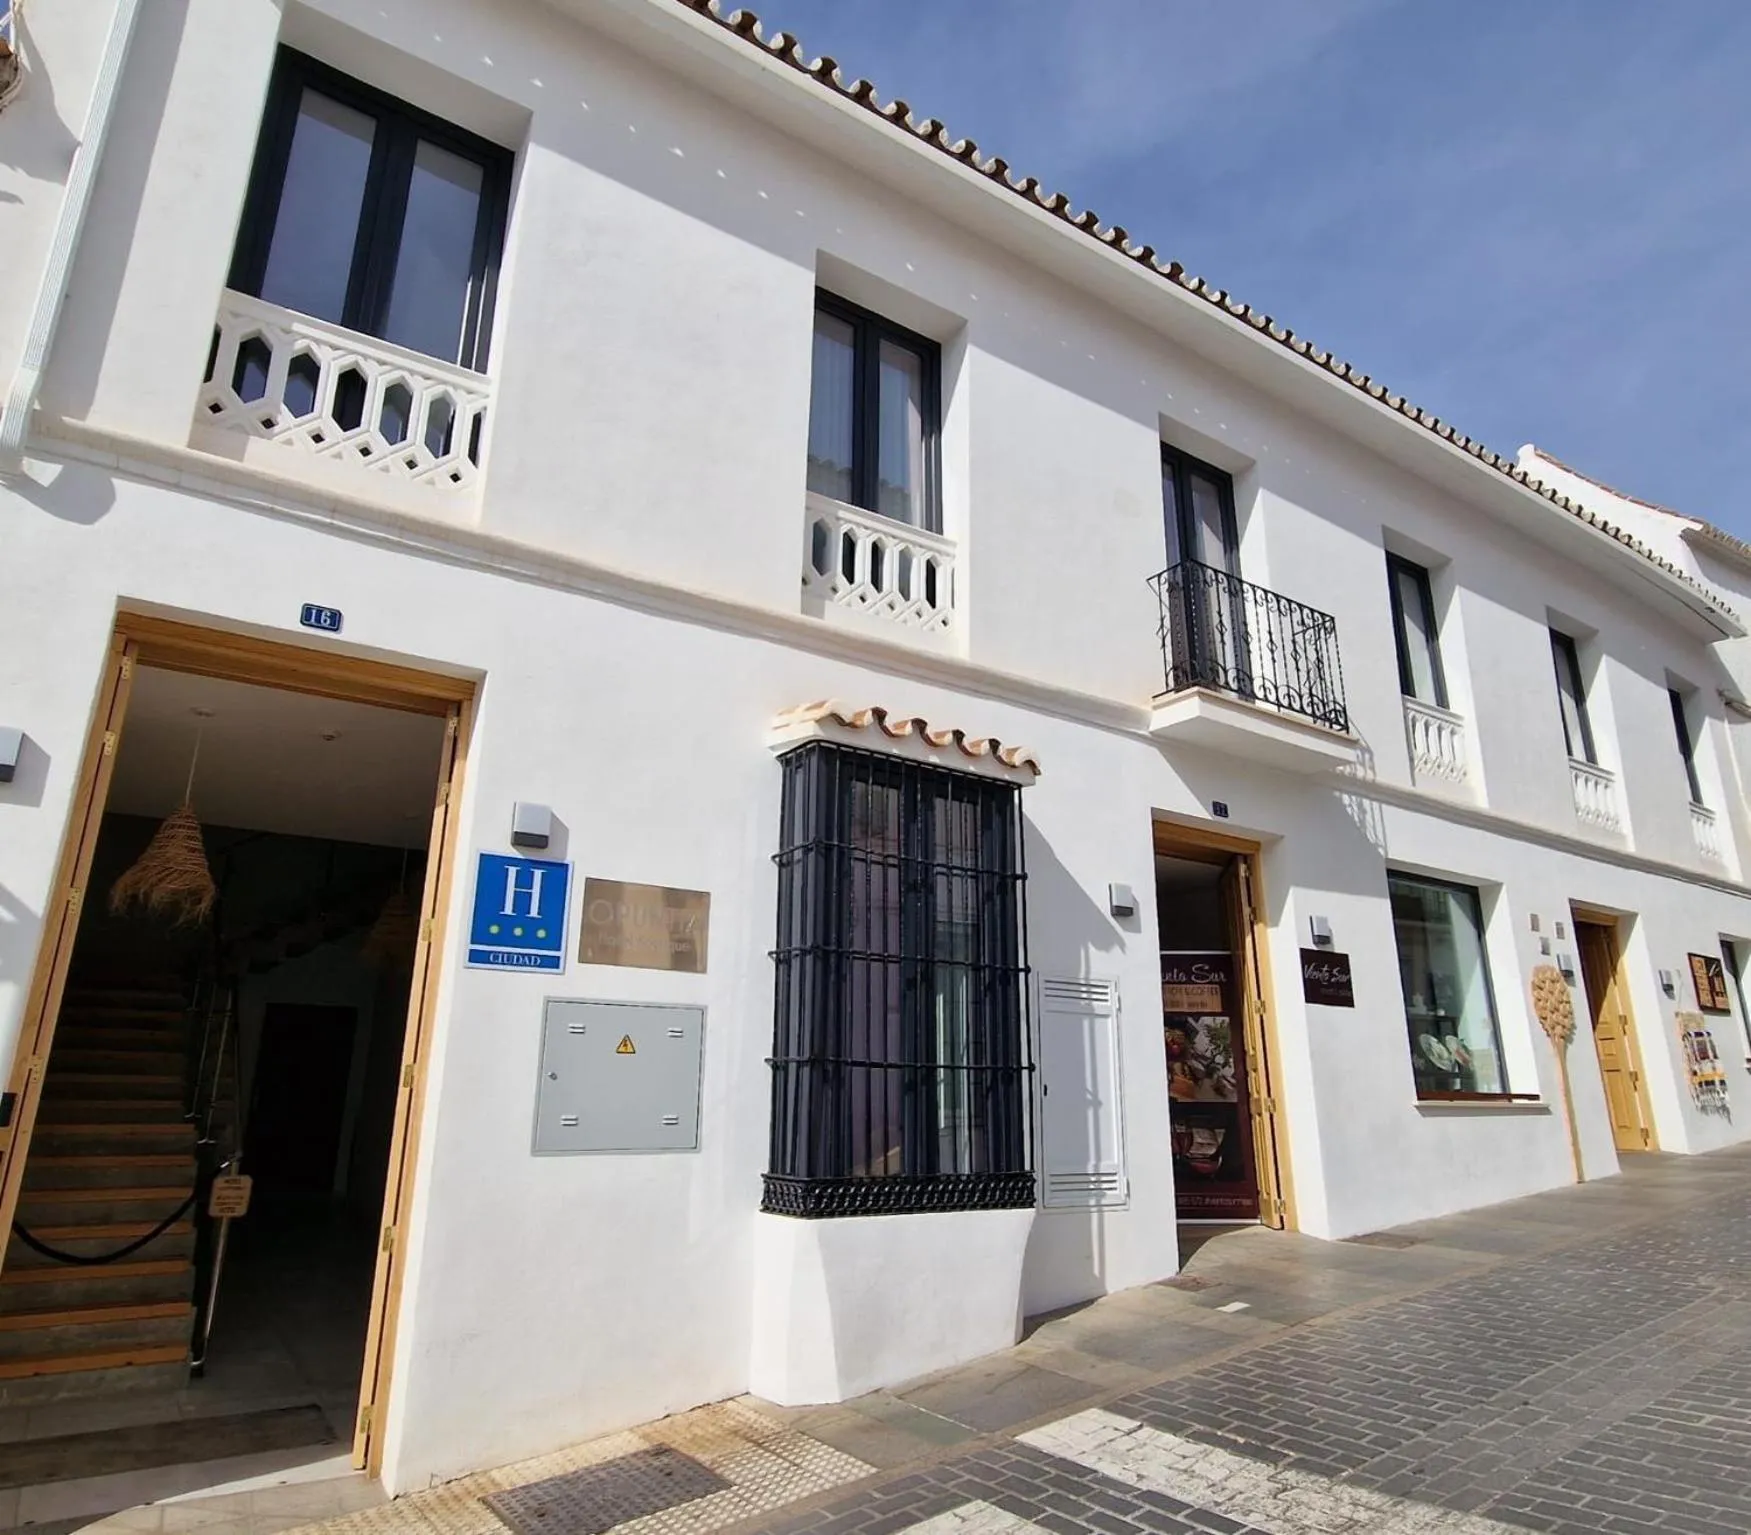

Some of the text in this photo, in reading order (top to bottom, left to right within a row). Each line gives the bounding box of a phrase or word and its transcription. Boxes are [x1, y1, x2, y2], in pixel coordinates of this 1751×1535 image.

[311, 609, 331, 626] 16
[499, 865, 548, 919] H
[489, 952, 541, 966] CIUDAD
[1190, 963, 1227, 984] Sur
